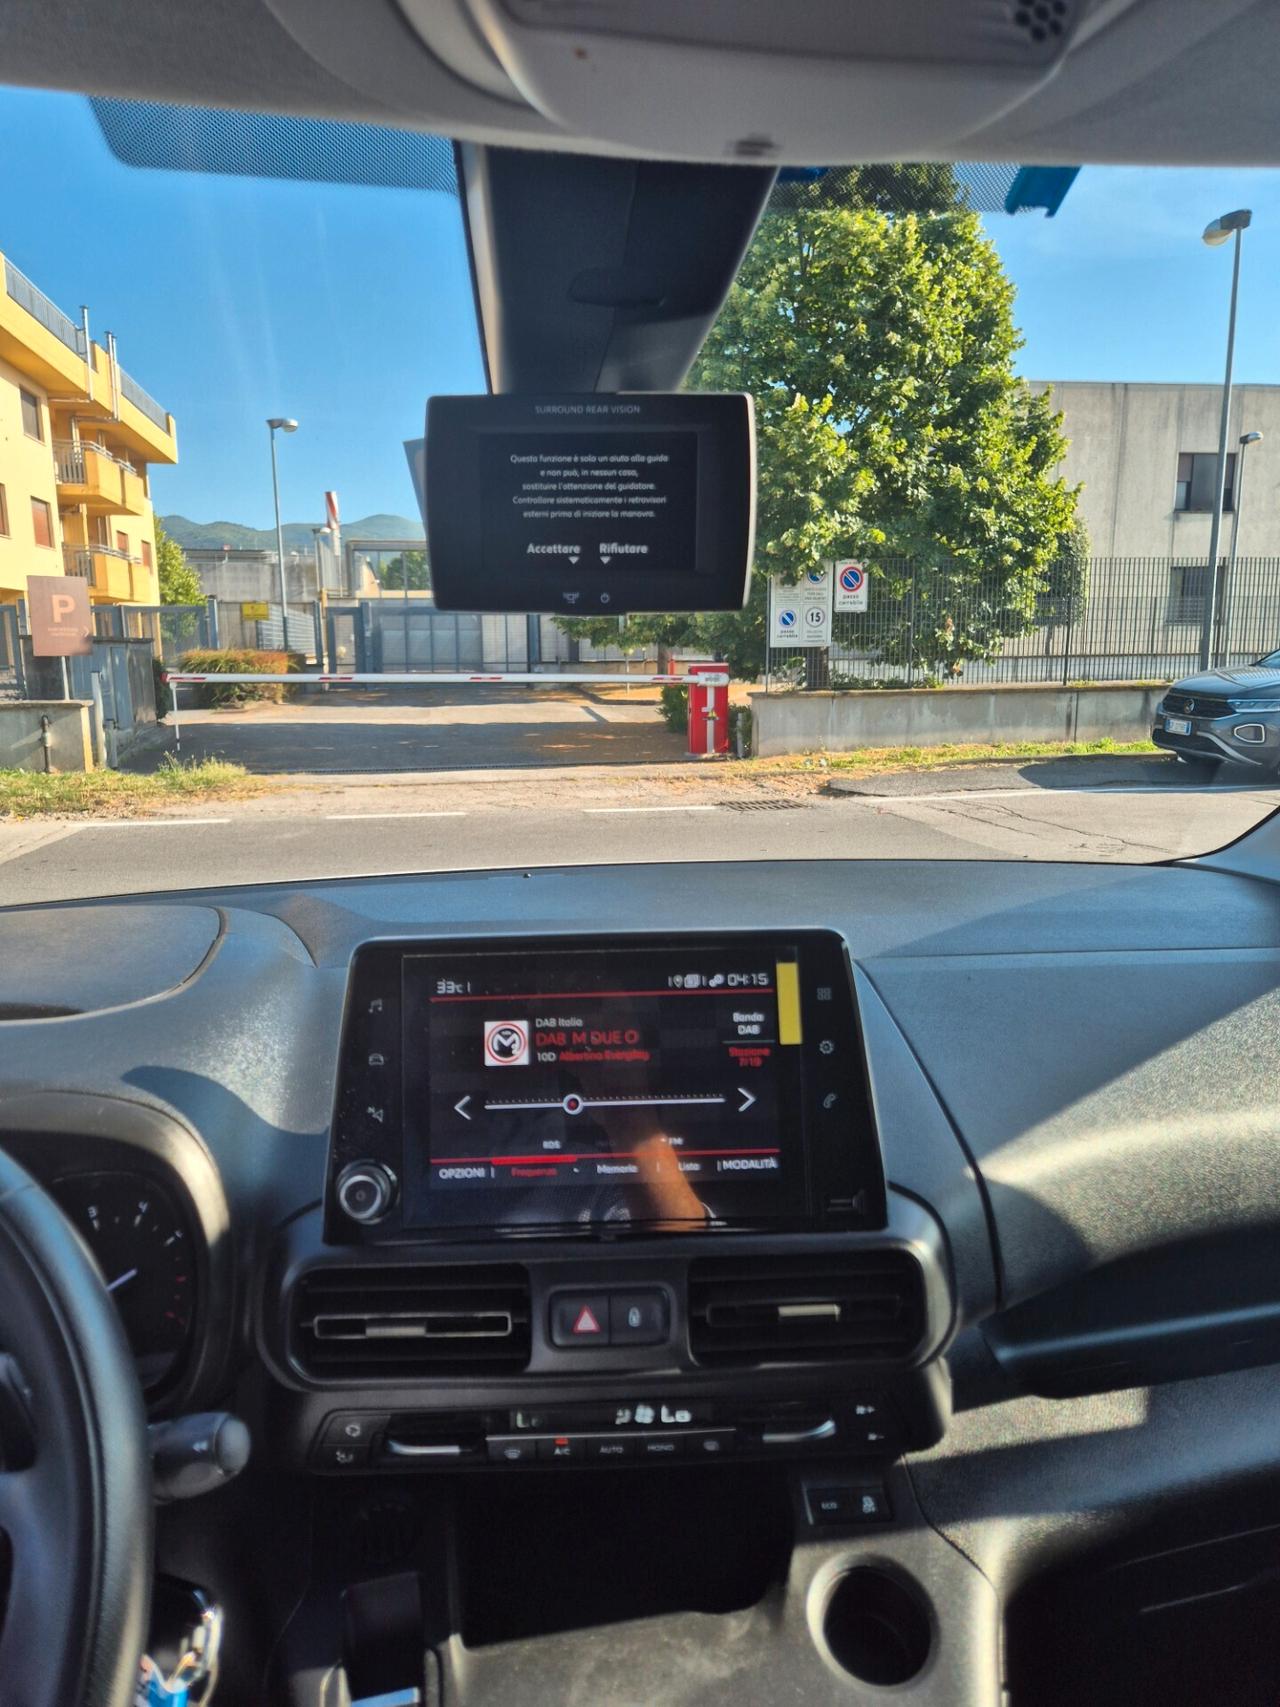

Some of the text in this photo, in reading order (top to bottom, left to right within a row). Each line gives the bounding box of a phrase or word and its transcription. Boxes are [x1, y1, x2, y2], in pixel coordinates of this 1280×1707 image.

[535, 405, 641, 414] SURROUND REAR VISION
[510, 454, 538, 464] Questa
[539, 454, 573, 463] funzione
[580, 454, 597, 463] solo
[609, 454, 629, 463] aiuto
[630, 454, 645, 463] alla
[646, 454, 669, 464] guida
[581, 468, 589, 477] in
[590, 469, 617, 477] nessun
[522, 482, 557, 491] sostituire
[604, 482, 616, 491] del
[512, 496, 555, 504] Controllare
[556, 496, 623, 504] sistematicamente
[523, 510, 549, 518] esterni
[550, 510, 573, 519] prima
[574, 509, 581, 518] di
[582, 510, 610, 518] iniziare
[611, 510, 620, 518] la
[526, 543, 581, 554] Accettare
[599, 543, 648, 554] Rifiutare
[52, 594, 75, 624] P
[810, 612, 821, 623] 15
[535, 1017, 583, 1027] DAB Italia
[733, 1012, 764, 1022] Banda
[737, 1024, 760, 1035] DAB
[536, 1032, 566, 1045] DAB
[572, 1031, 586, 1044] M
[439, 1167, 486, 1179] OPZIONI
[600, 1446, 625, 1455] AUTO
